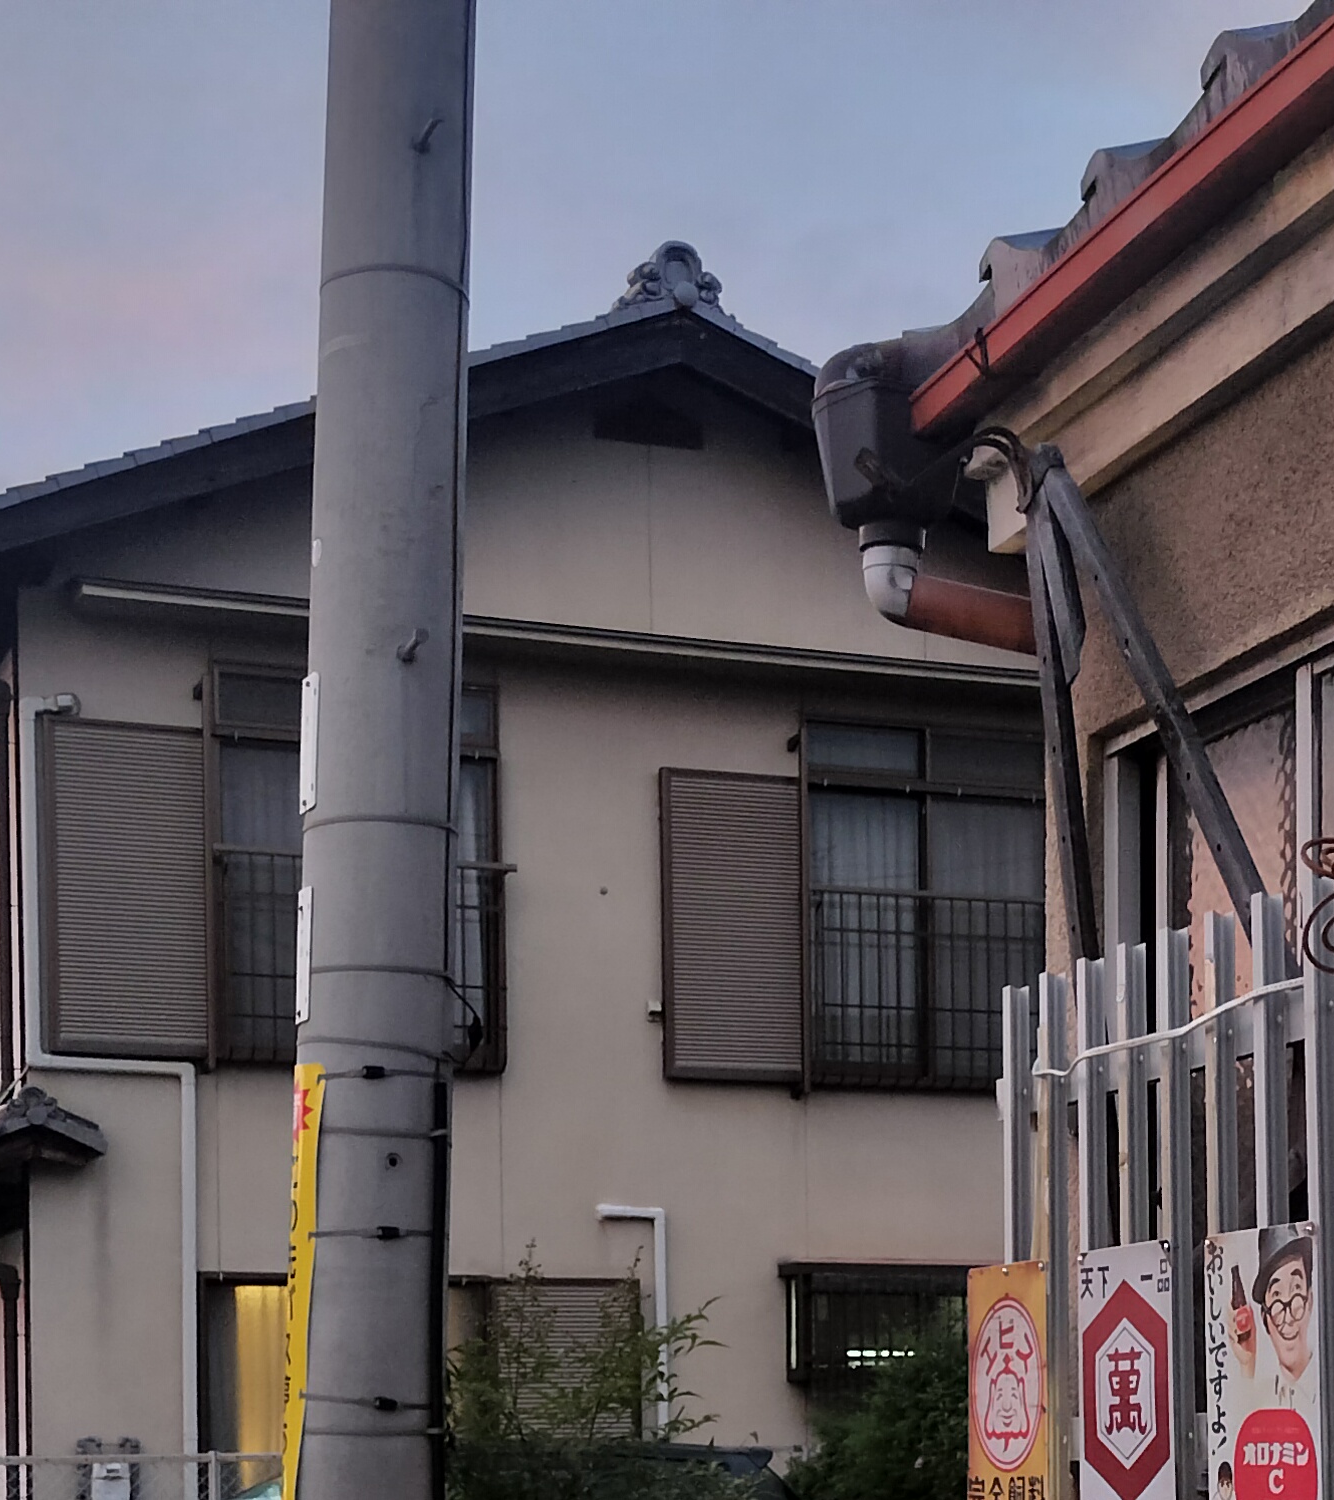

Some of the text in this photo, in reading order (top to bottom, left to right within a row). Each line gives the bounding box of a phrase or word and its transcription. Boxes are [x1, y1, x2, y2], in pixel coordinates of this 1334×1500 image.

[1079, 1266, 1110, 1299] 天下
[1242, 1441, 1309, 1467] オロナミン
[1268, 1468, 1285, 1495] C
